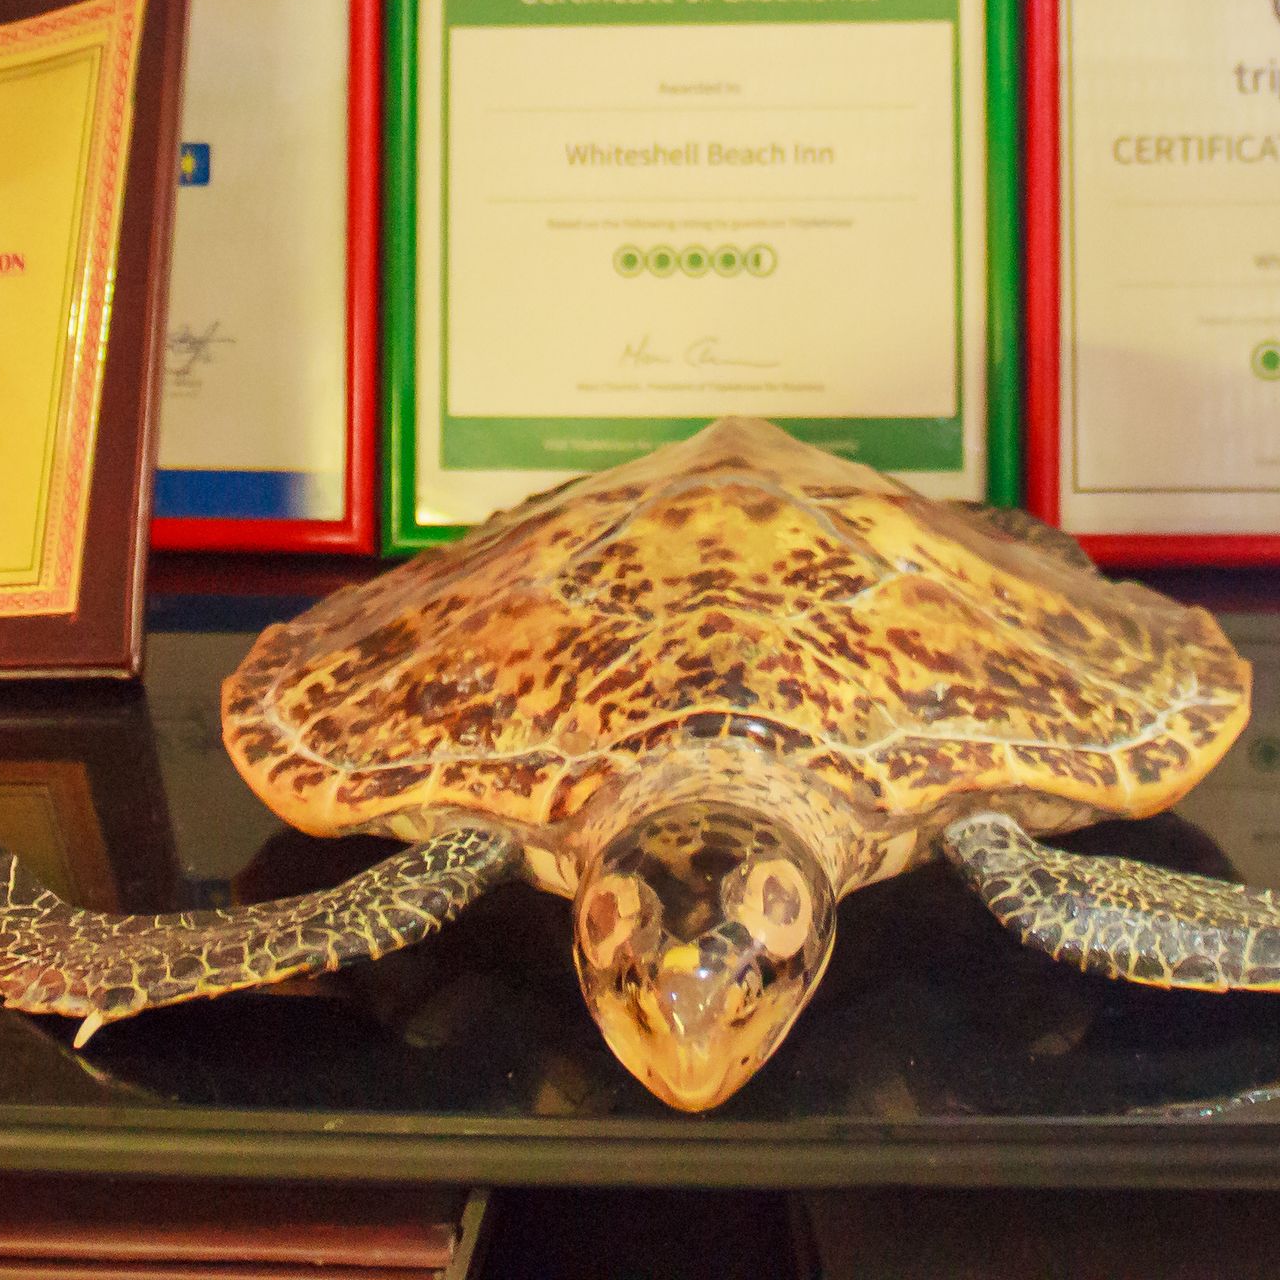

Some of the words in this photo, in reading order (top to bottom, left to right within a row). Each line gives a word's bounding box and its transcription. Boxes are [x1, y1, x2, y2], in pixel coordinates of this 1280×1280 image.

[565, 142, 699, 168] Whiteshell
[707, 142, 786, 166] Beach
[794, 142, 835, 166] Inn
